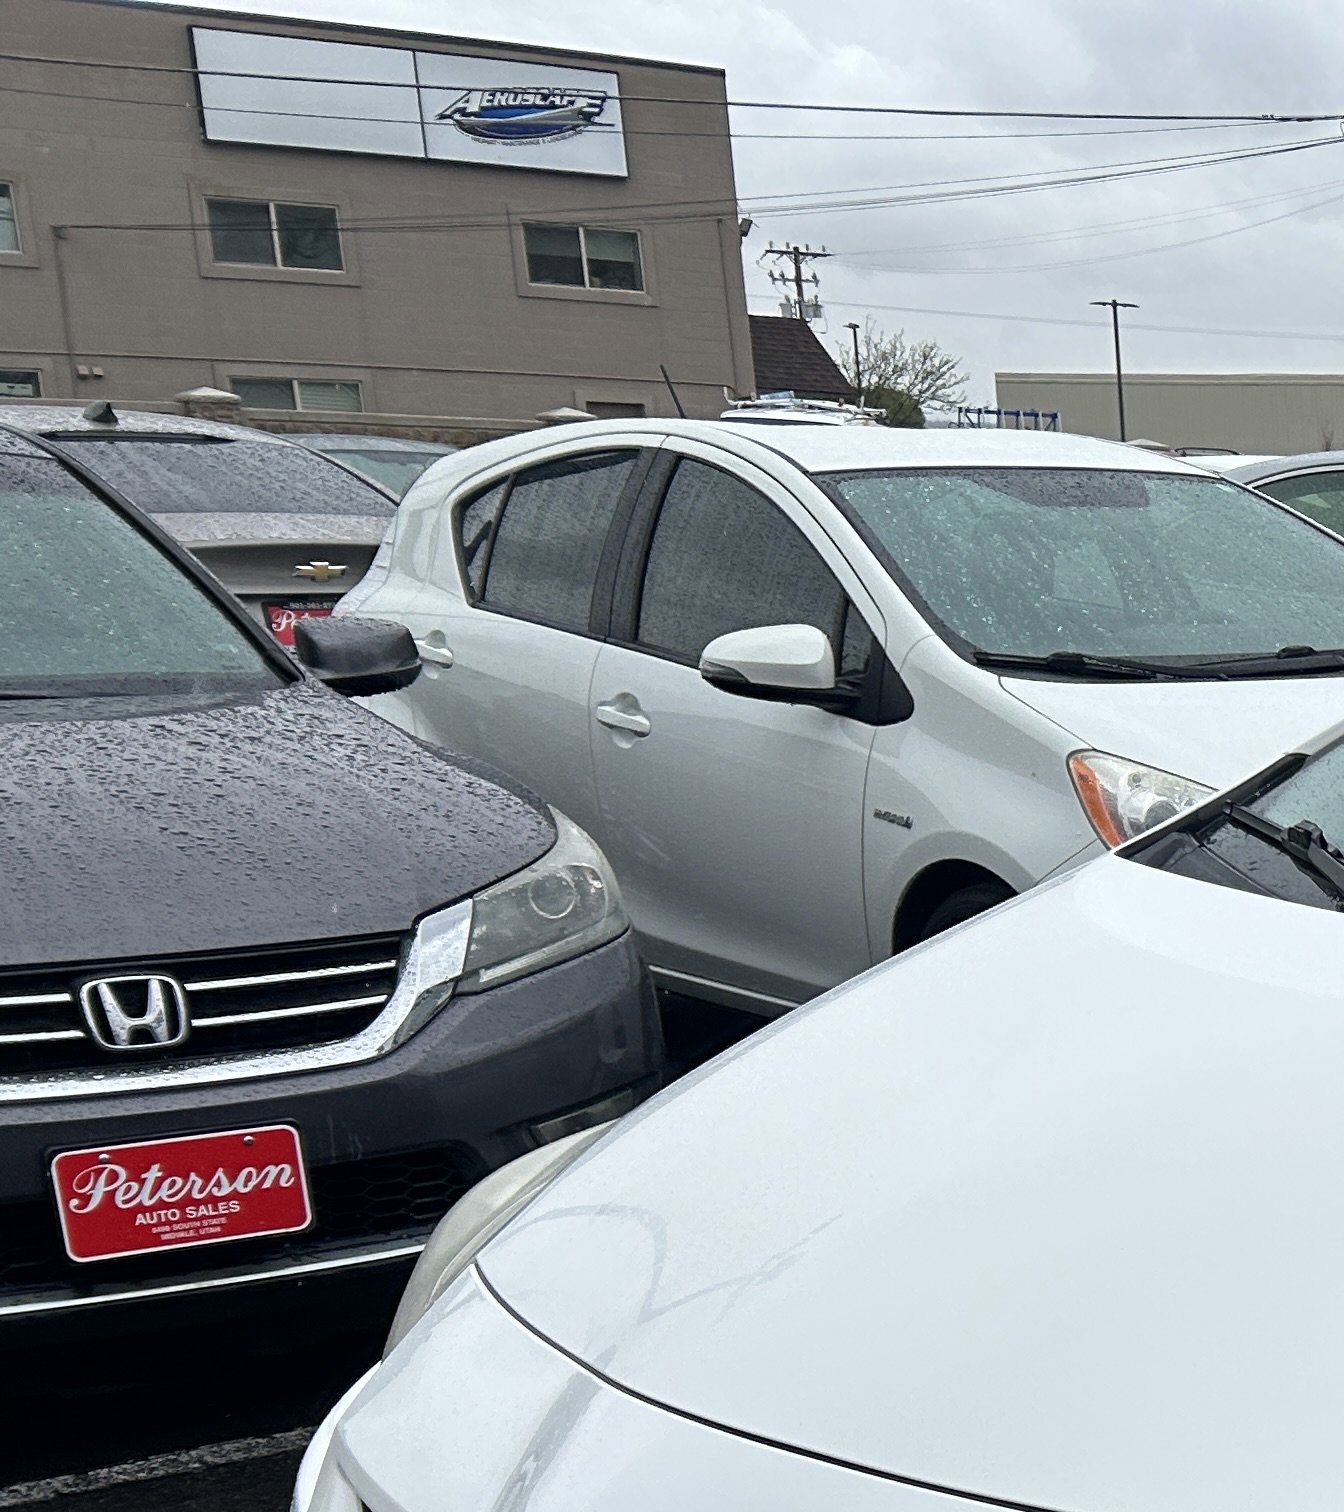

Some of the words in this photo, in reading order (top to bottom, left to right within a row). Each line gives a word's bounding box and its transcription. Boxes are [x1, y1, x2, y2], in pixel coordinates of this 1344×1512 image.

[69, 1163, 295, 1214] Peterson
[135, 1208, 180, 1226] AUTO
[185, 1200, 240, 1218] SALES
